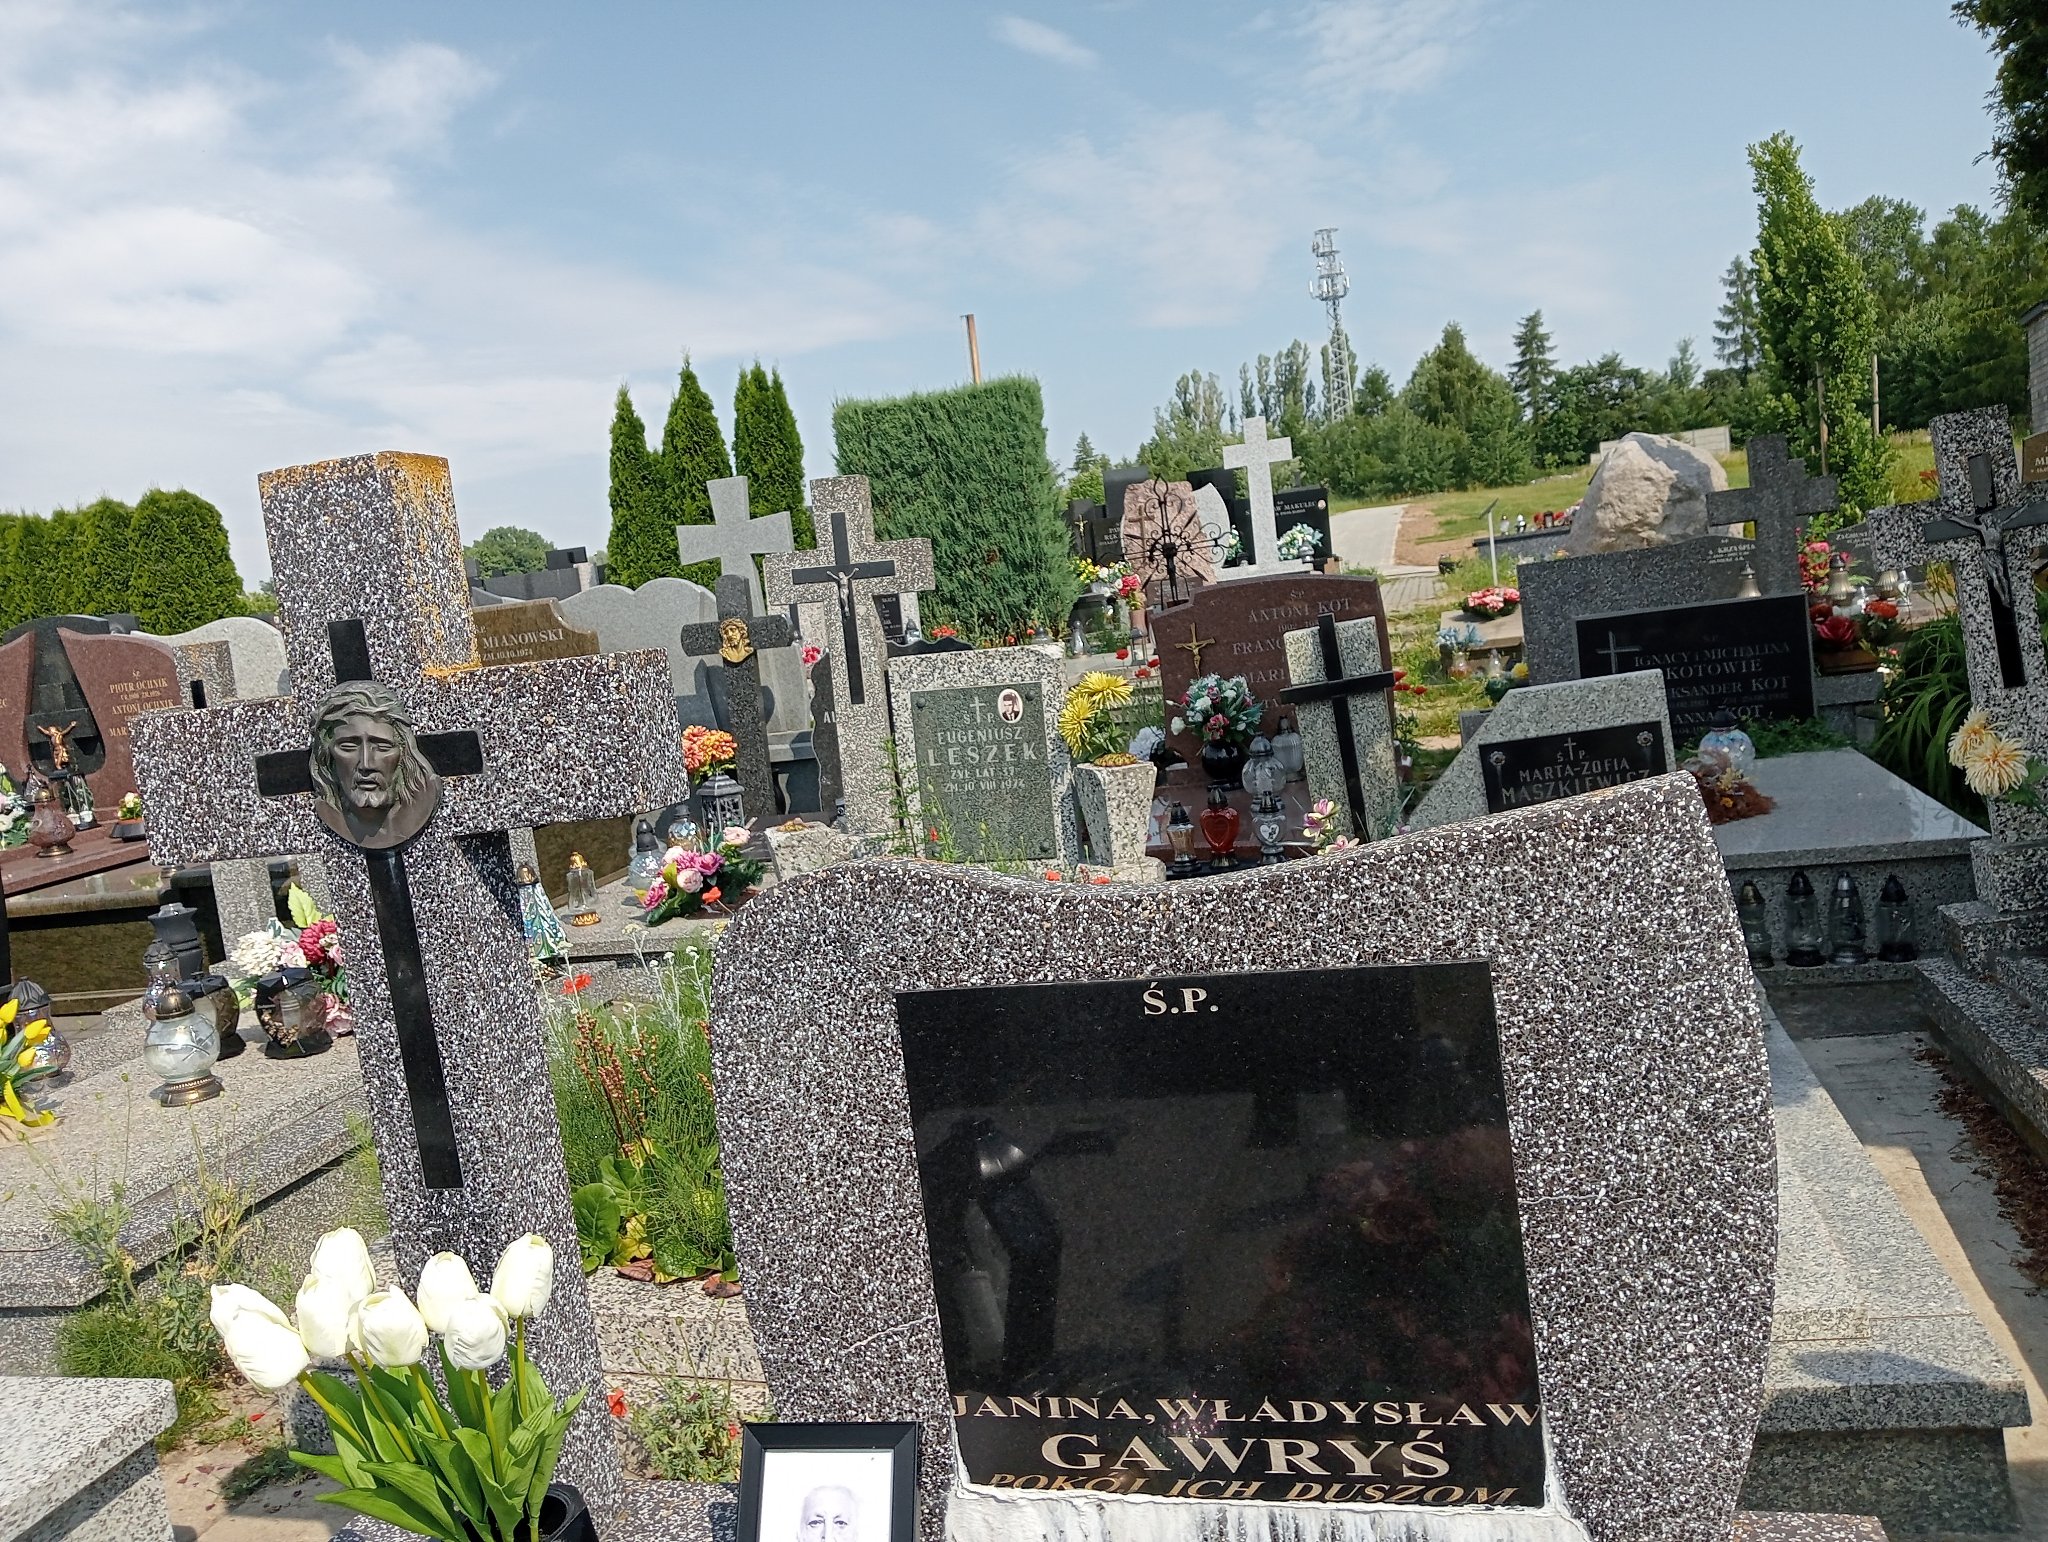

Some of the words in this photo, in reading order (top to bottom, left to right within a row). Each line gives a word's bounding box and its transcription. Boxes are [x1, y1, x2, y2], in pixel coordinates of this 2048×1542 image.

[1249, 605, 1309, 623] ANTONI
[1318, 599, 1351, 613] KOT
[1635, 651, 1690, 667] IGNACY
[1704, 641, 1790, 661] MICHALINA
[1666, 658, 1763, 680] KOTOWIE
[110, 682, 135, 694] PIOTR
[1670, 681, 1742, 698] KSANDER
[1751, 675, 1790, 692] KOT
[112, 703, 141, 715] ANTONI
[938, 727, 1023, 745] EUGENIUSZ
[927, 742, 1037, 766] LESZEK
[976, 767, 995, 779] LAT
[1519, 757, 1630, 782] MARTA-ZOFIA
[1041, 1429, 1450, 1480] GAWRYŚ
[989, 1471, 1150, 1494] POKÓJ
[1166, 1479, 1266, 1499] ICH
[1284, 1481, 1520, 1505] DUSZOM
